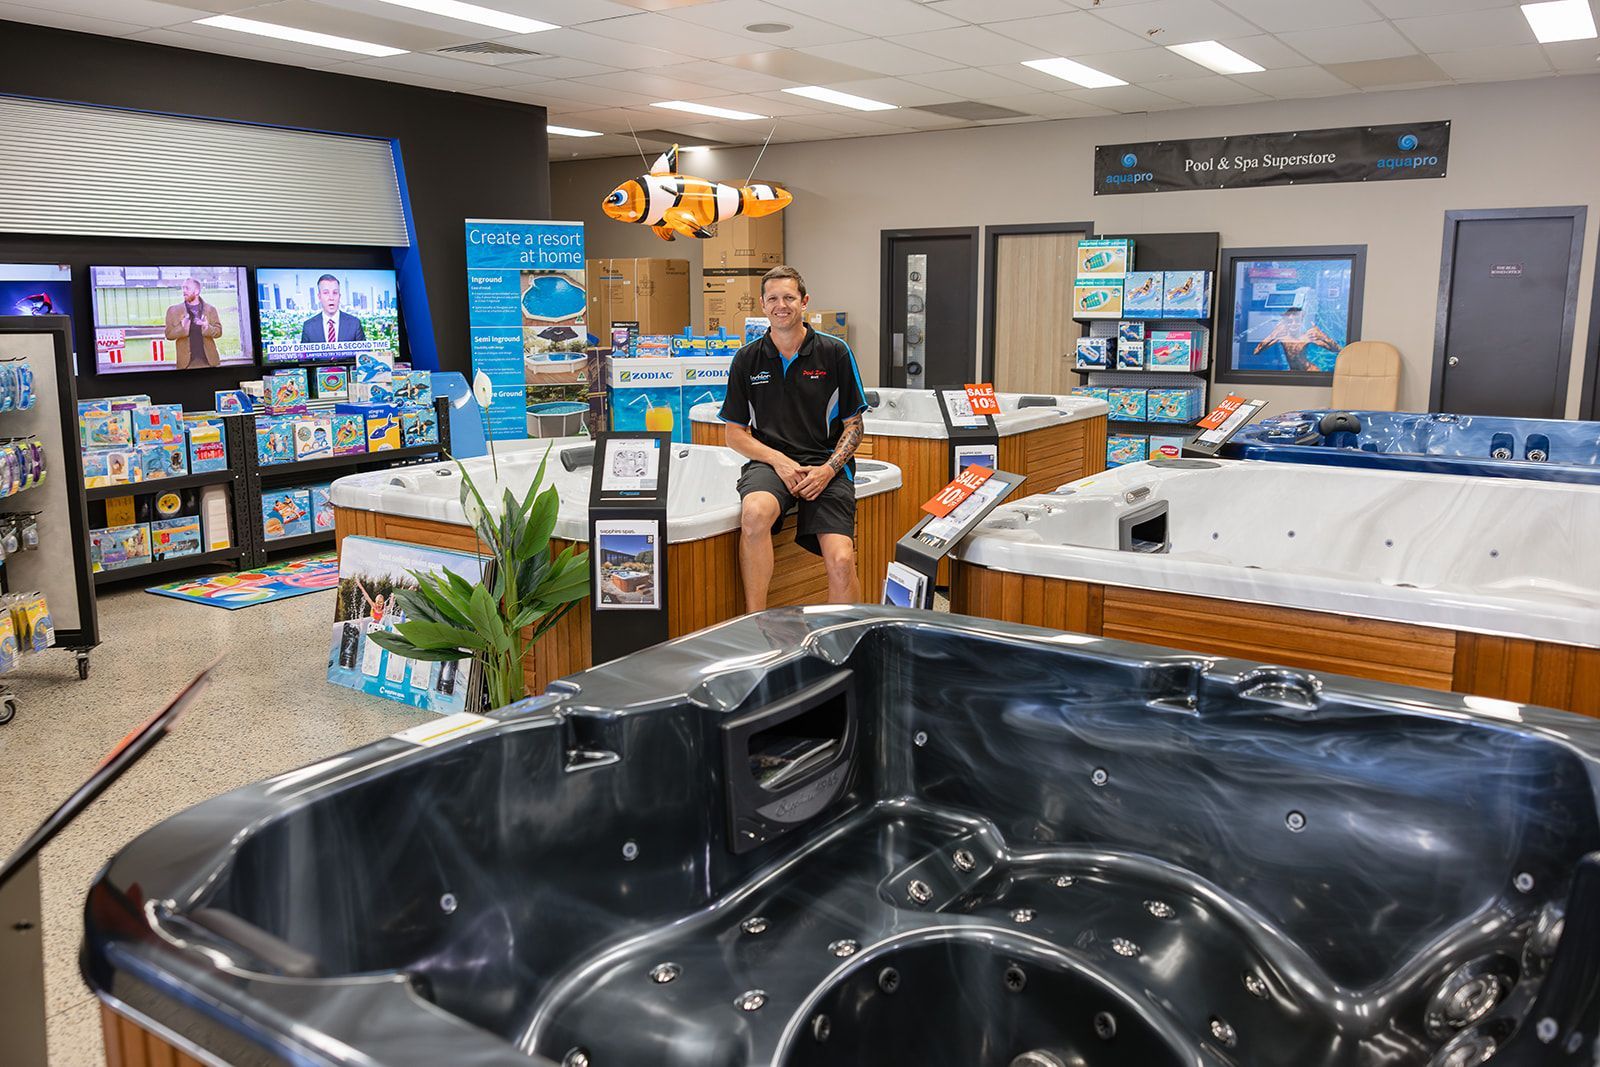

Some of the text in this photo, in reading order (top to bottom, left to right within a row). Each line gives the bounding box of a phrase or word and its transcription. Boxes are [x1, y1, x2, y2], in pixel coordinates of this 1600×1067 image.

[1185, 151, 1337, 172] Pool & Spa Superstore
[1376, 153, 1438, 170] aquapro
[1105, 170, 1154, 185] aquapro
[470, 229, 581, 246] Create a resort
[520, 247, 582, 263] at home
[471, 276, 503, 284] Inground
[491, 335, 521, 344] Inground
[269, 344, 293, 353] DIDDY
[294, 343, 320, 352] DENIED
[321, 342, 337, 351] BAIL
[337, 342, 343, 350] A
[343, 342, 372, 350] SECOND
[632, 371, 673, 380] ZODIAC
[697, 370, 730, 378] ZODIA
[498, 390, 523, 398] Ground
[967, 387, 993, 397] SALE
[1218, 400, 1242, 411] SALE
[955, 470, 986, 490] SALE
